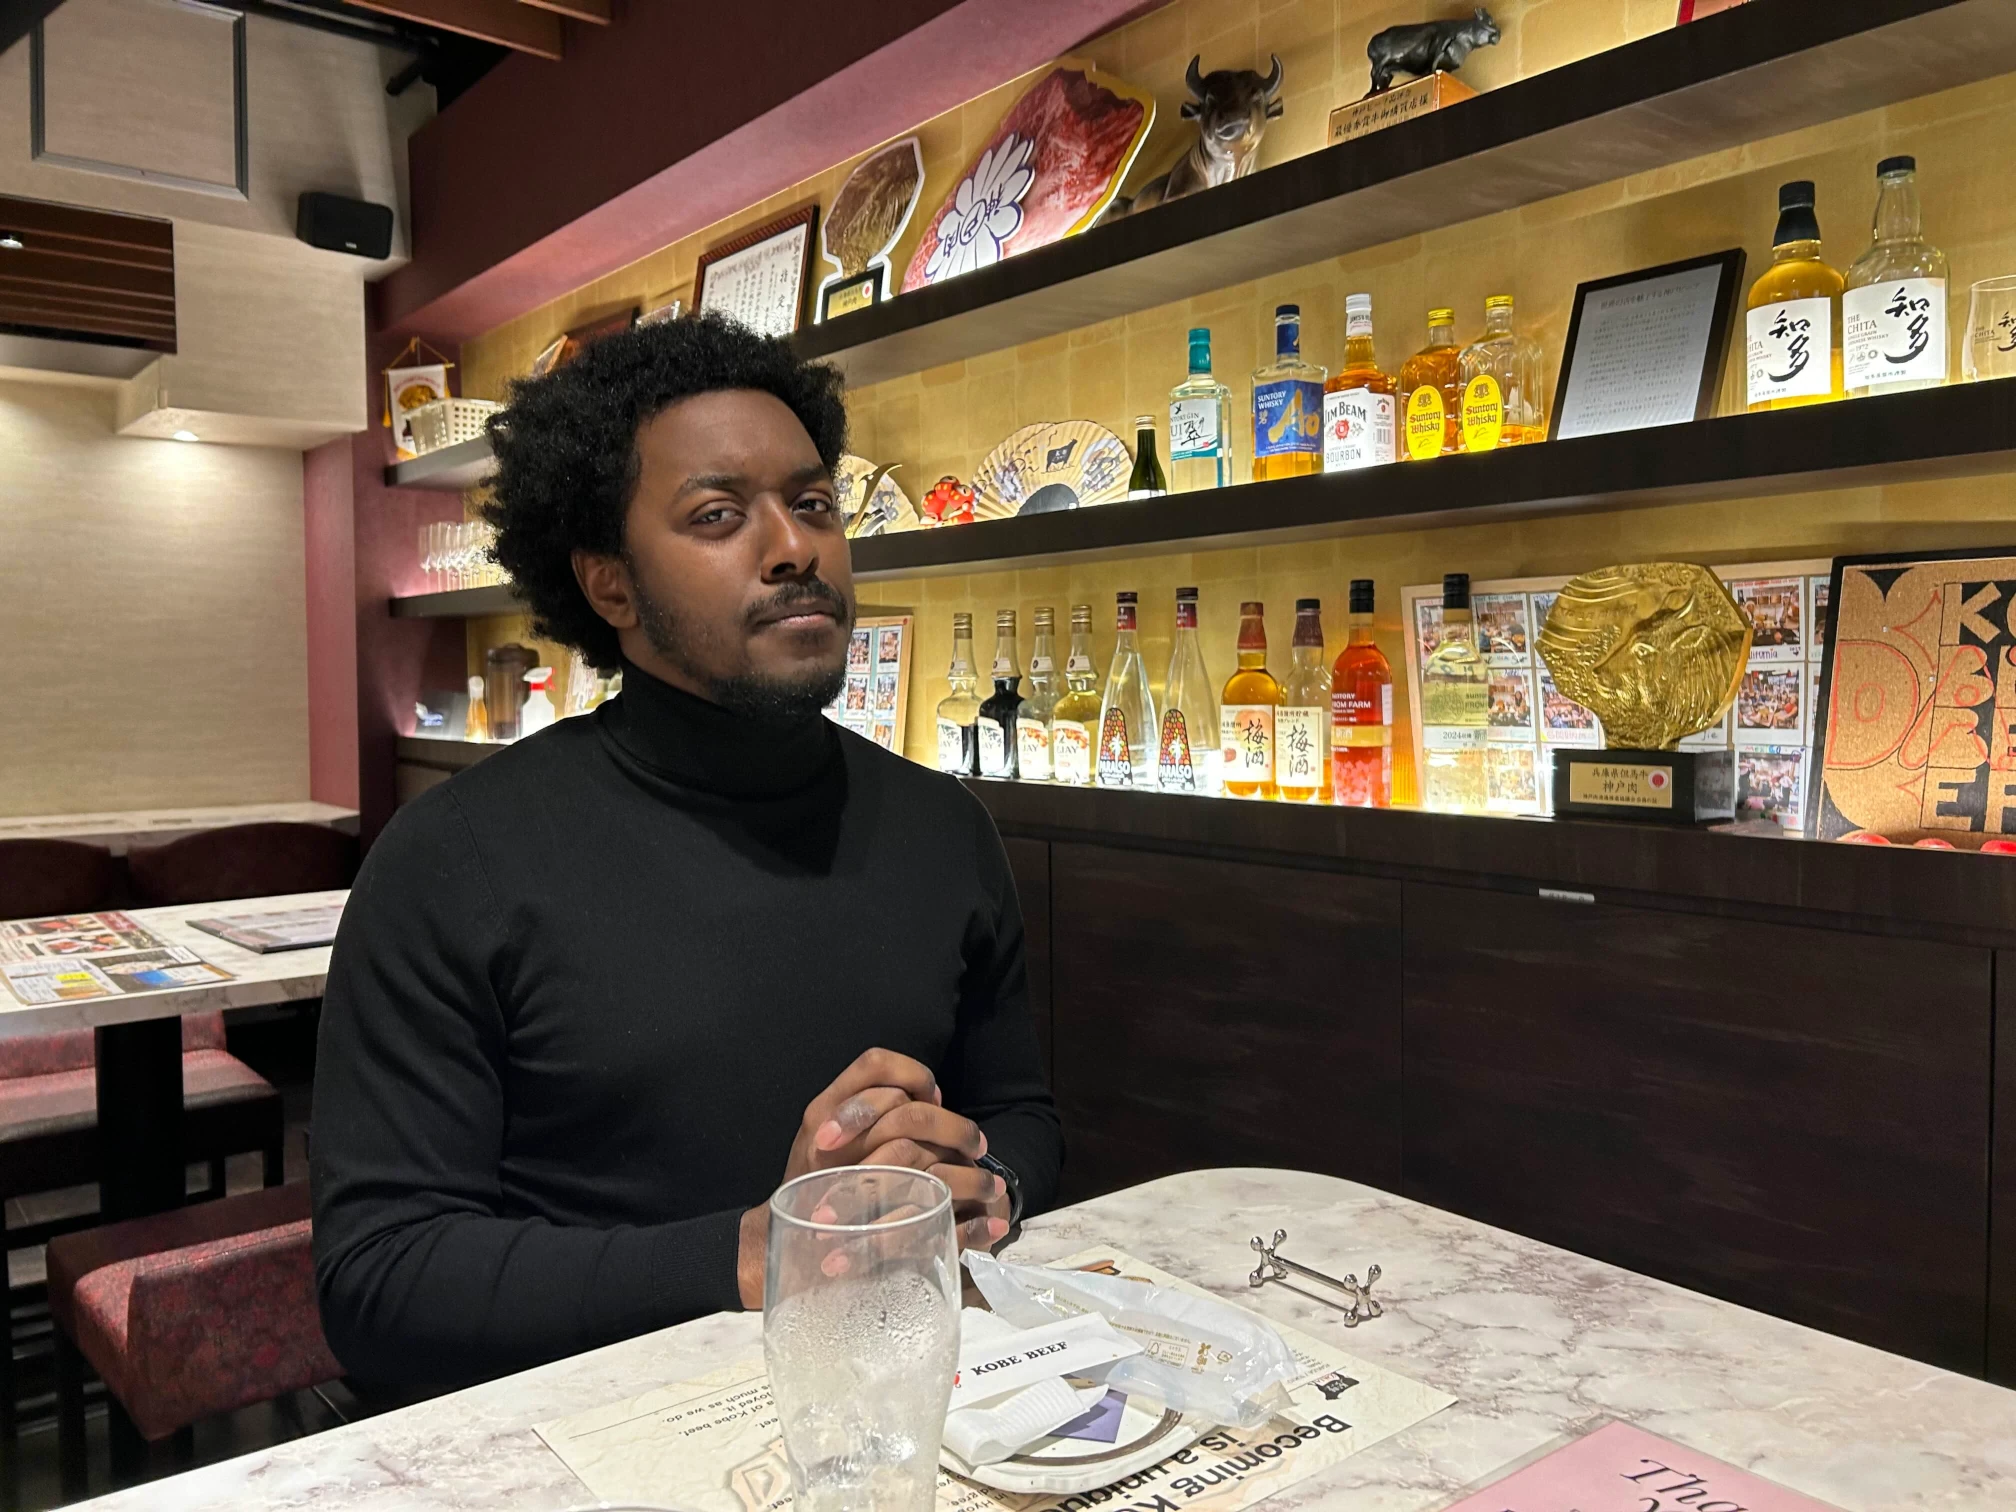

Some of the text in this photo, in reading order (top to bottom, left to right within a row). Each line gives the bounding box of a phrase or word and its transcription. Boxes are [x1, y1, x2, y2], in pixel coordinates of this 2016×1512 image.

[1848, 314, 1860, 324] THE
[1884, 287, 1930, 364] 知多
[1848, 320, 1877, 335] CHITA
[1749, 341, 1763, 352] HITA
[1768, 309, 1811, 382] 知多
[1257, 391, 1286, 402] SUNTORY
[1258, 399, 1283, 410] WHISKY
[1466, 403, 1498, 415] Suntory
[1339, 402, 1367, 422] BEAM
[1410, 411, 1440, 423] Suntory
[1467, 414, 1497, 426] Whisky
[1171, 423, 1182, 437] UI
[1411, 422, 1440, 434] Whisky
[1326, 448, 1362, 464] BOURBON
[1242, 718, 1268, 768] 梅酒
[1286, 723, 1314, 778] 梅酒
[1603, 780, 1638, 794] 神戸肉
[970, 1341, 1068, 1376] KOBE BEEF
[726, 1388, 759, 1403] much
[687, 1407, 705, 1416] we
[708, 1401, 723, 1409] as
[750, 1404, 763, 1413] of
[662, 1414, 683, 1423] do.
[714, 1410, 749, 1425] Kobe
[755, 1417, 779, 1429] eef.
[679, 1422, 713, 1437] beef.
[1200, 1431, 1245, 1452] is
[1170, 1413, 1353, 1498] Becoming
[767, 1496, 793, 1510] eef.
[947, 1486, 996, 1506] edigree.
